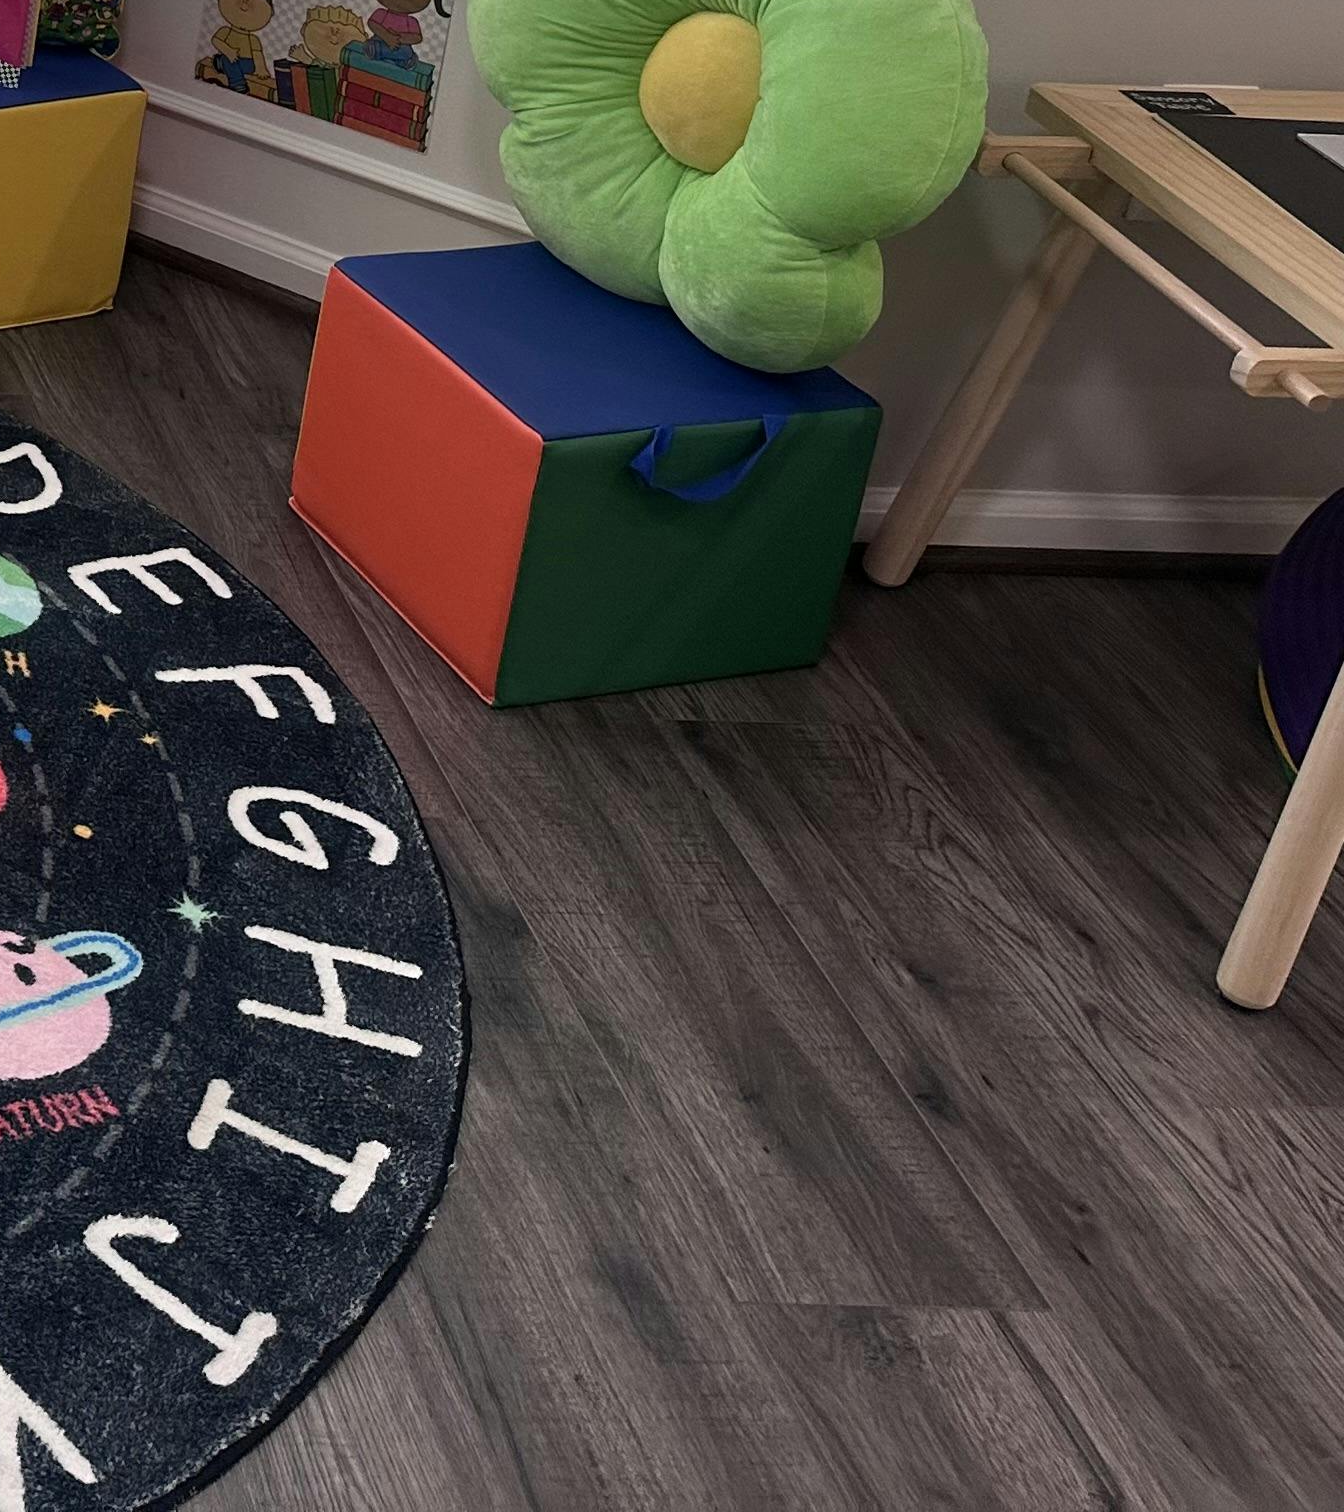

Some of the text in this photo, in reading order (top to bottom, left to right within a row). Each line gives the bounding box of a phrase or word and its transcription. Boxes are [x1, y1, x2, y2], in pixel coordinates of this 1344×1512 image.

[68, 547, 232, 614] E
[154, 663, 337, 724] F
[227, 786, 400, 871] G
[239, 925, 423, 1057] H
[187, 1078, 392, 1213] I
[83, 1213, 278, 1386] J
